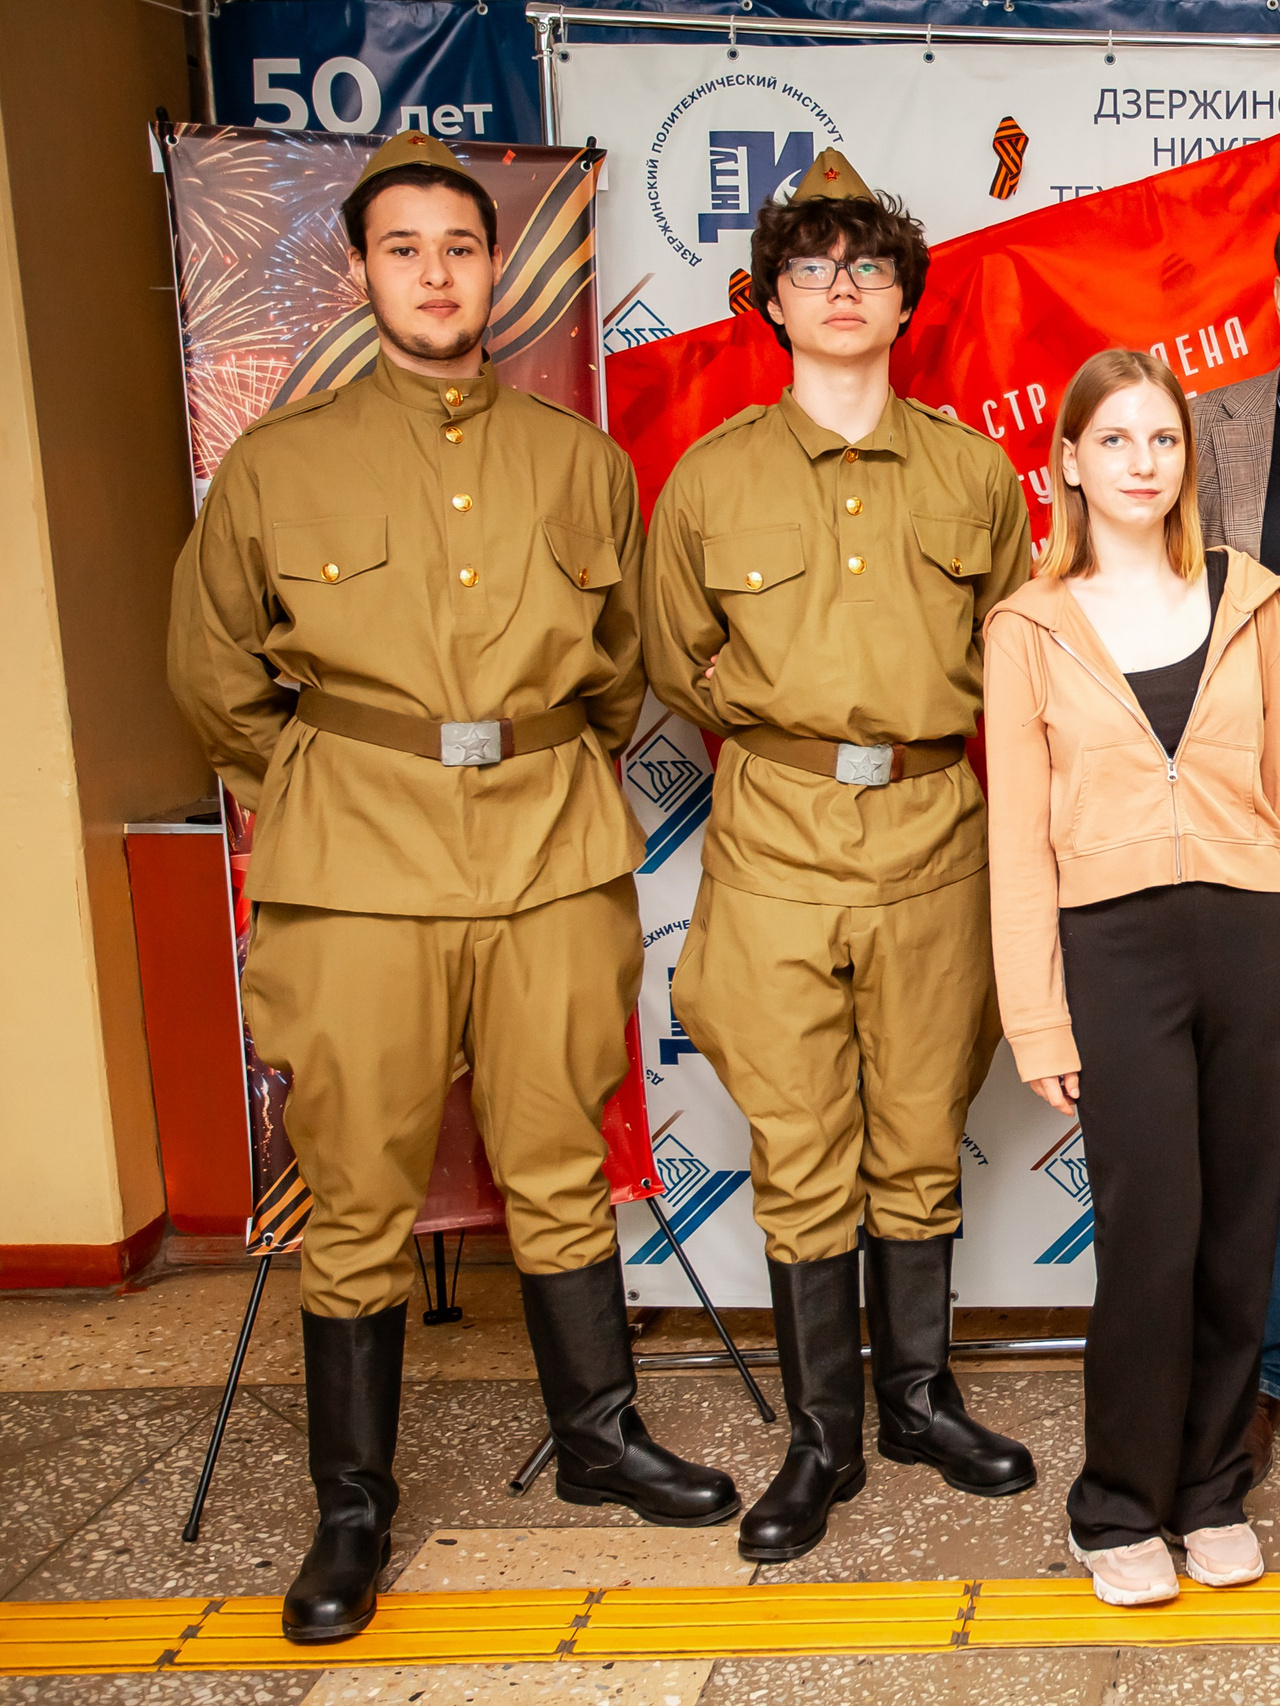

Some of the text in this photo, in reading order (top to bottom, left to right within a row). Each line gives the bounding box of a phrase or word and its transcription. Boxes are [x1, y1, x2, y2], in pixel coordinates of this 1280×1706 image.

[253, 56, 493, 135] 50 лет
[645, 74, 844, 268] ДЗЕРЖИНСКИЙ ПОЛИТЕХНИЧЕСКИЙ ИНСТИТУТ
